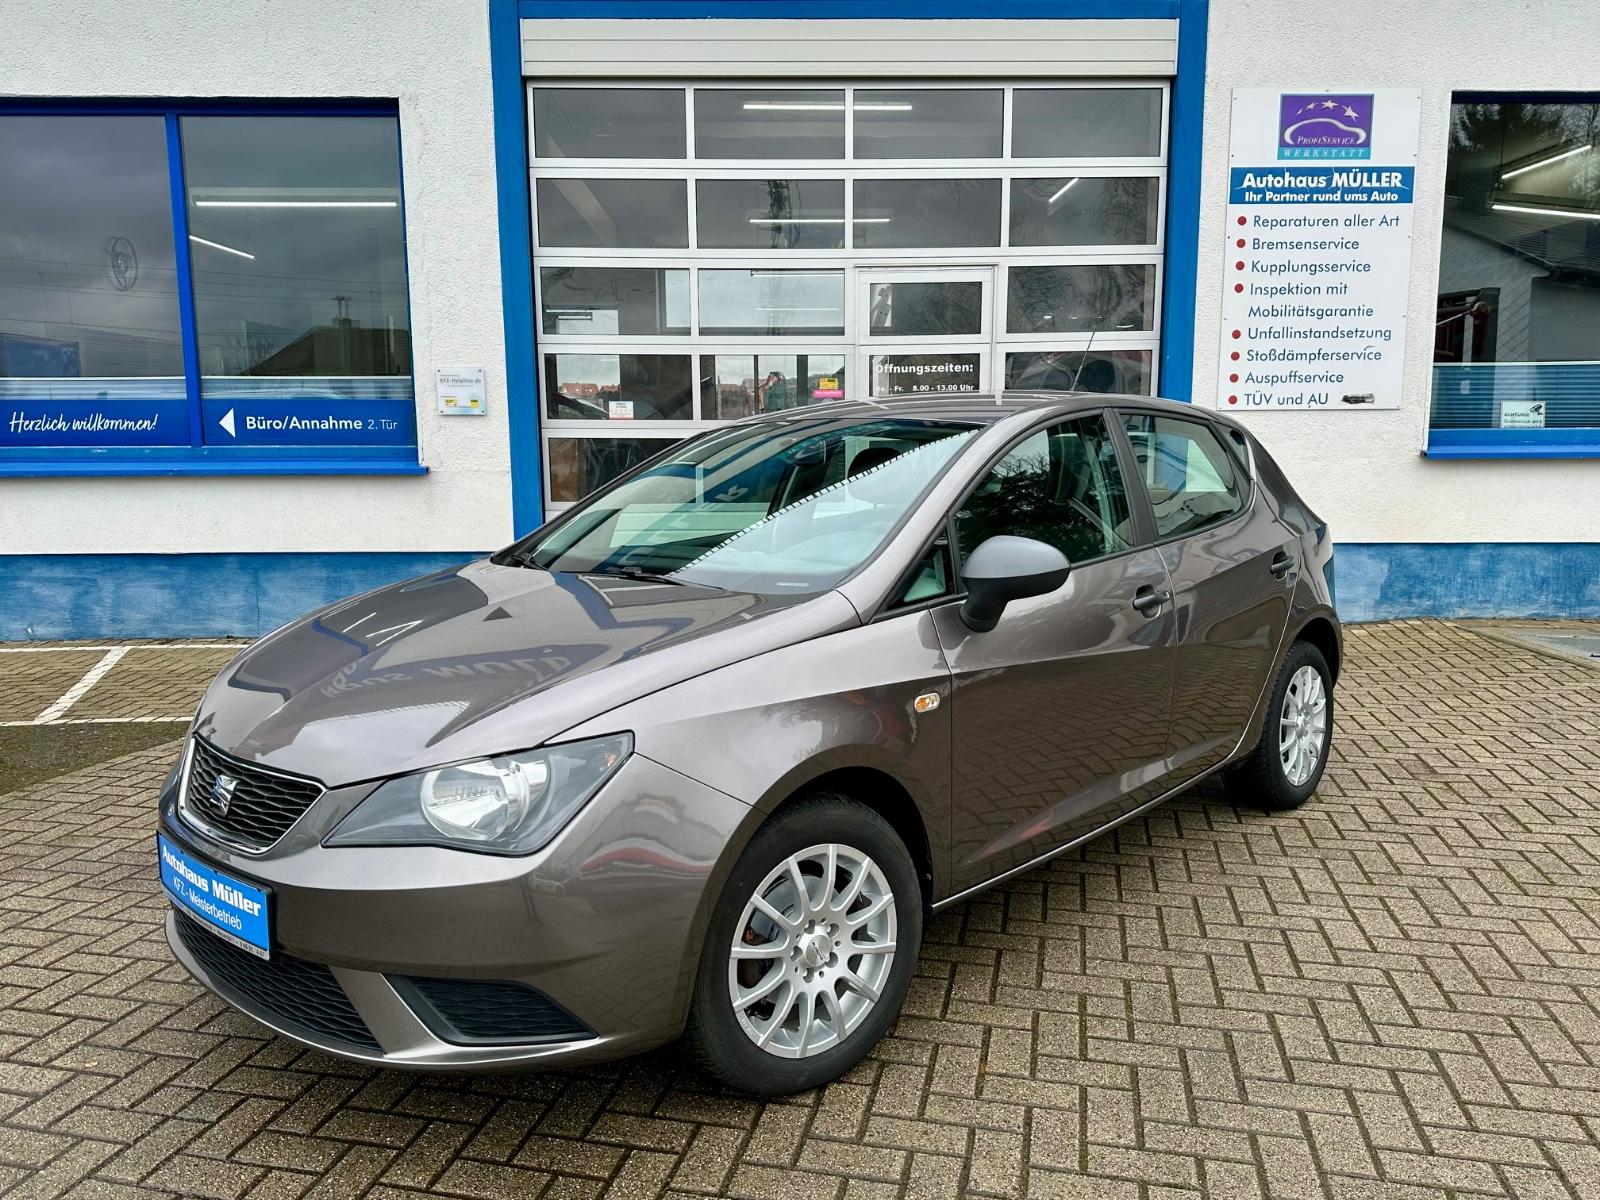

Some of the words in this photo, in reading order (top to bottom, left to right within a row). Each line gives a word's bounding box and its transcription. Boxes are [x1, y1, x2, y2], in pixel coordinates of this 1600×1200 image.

[1283, 149, 1365, 157] WERKSTATT
[1243, 173, 1326, 188] Autohaus
[1331, 169, 1402, 187] MÜLLER
[1245, 191, 1262, 202] Ihr
[1265, 191, 1310, 202] Partner
[1313, 190, 1341, 201] rund
[1344, 193, 1368, 201] ums
[1371, 191, 1398, 201] Auto
[1253, 215, 1339, 230] Reparaturen
[1344, 214, 1375, 227] aller
[1379, 214, 1400, 227] Art
[1252, 237, 1359, 250] Bremsenservice
[1251, 259, 1371, 275] Kupplungsservice
[1250, 282, 1321, 298] Inspektion
[1326, 282, 1348, 295] mit
[1248, 304, 1374, 319] Mobilitätsgarantie
[1248, 326, 1392, 341] Unfallinstandsetzung
[1246, 348, 1382, 363] Stoßdämpferservice
[1245, 370, 1344, 386] Auspuffservice
[912, 384, 930, 392] 8.00
[936, 384, 958, 392] 13.00
[1244, 390, 1273, 405] TÜV
[1277, 392, 1304, 405] und
[1308, 393, 1329, 405] AU
[9, 411, 70, 434] Herzlich
[72, 413, 159, 432] willkommen!
[246, 415, 363, 430] Büro/Annahme
[367, 419, 378, 430] 2.
[380, 418, 398, 430] Tür
[162, 844, 209, 893] Autohaus
[211, 879, 261, 917] Müller
[189, 887, 242, 930] Meisterbetrieb
